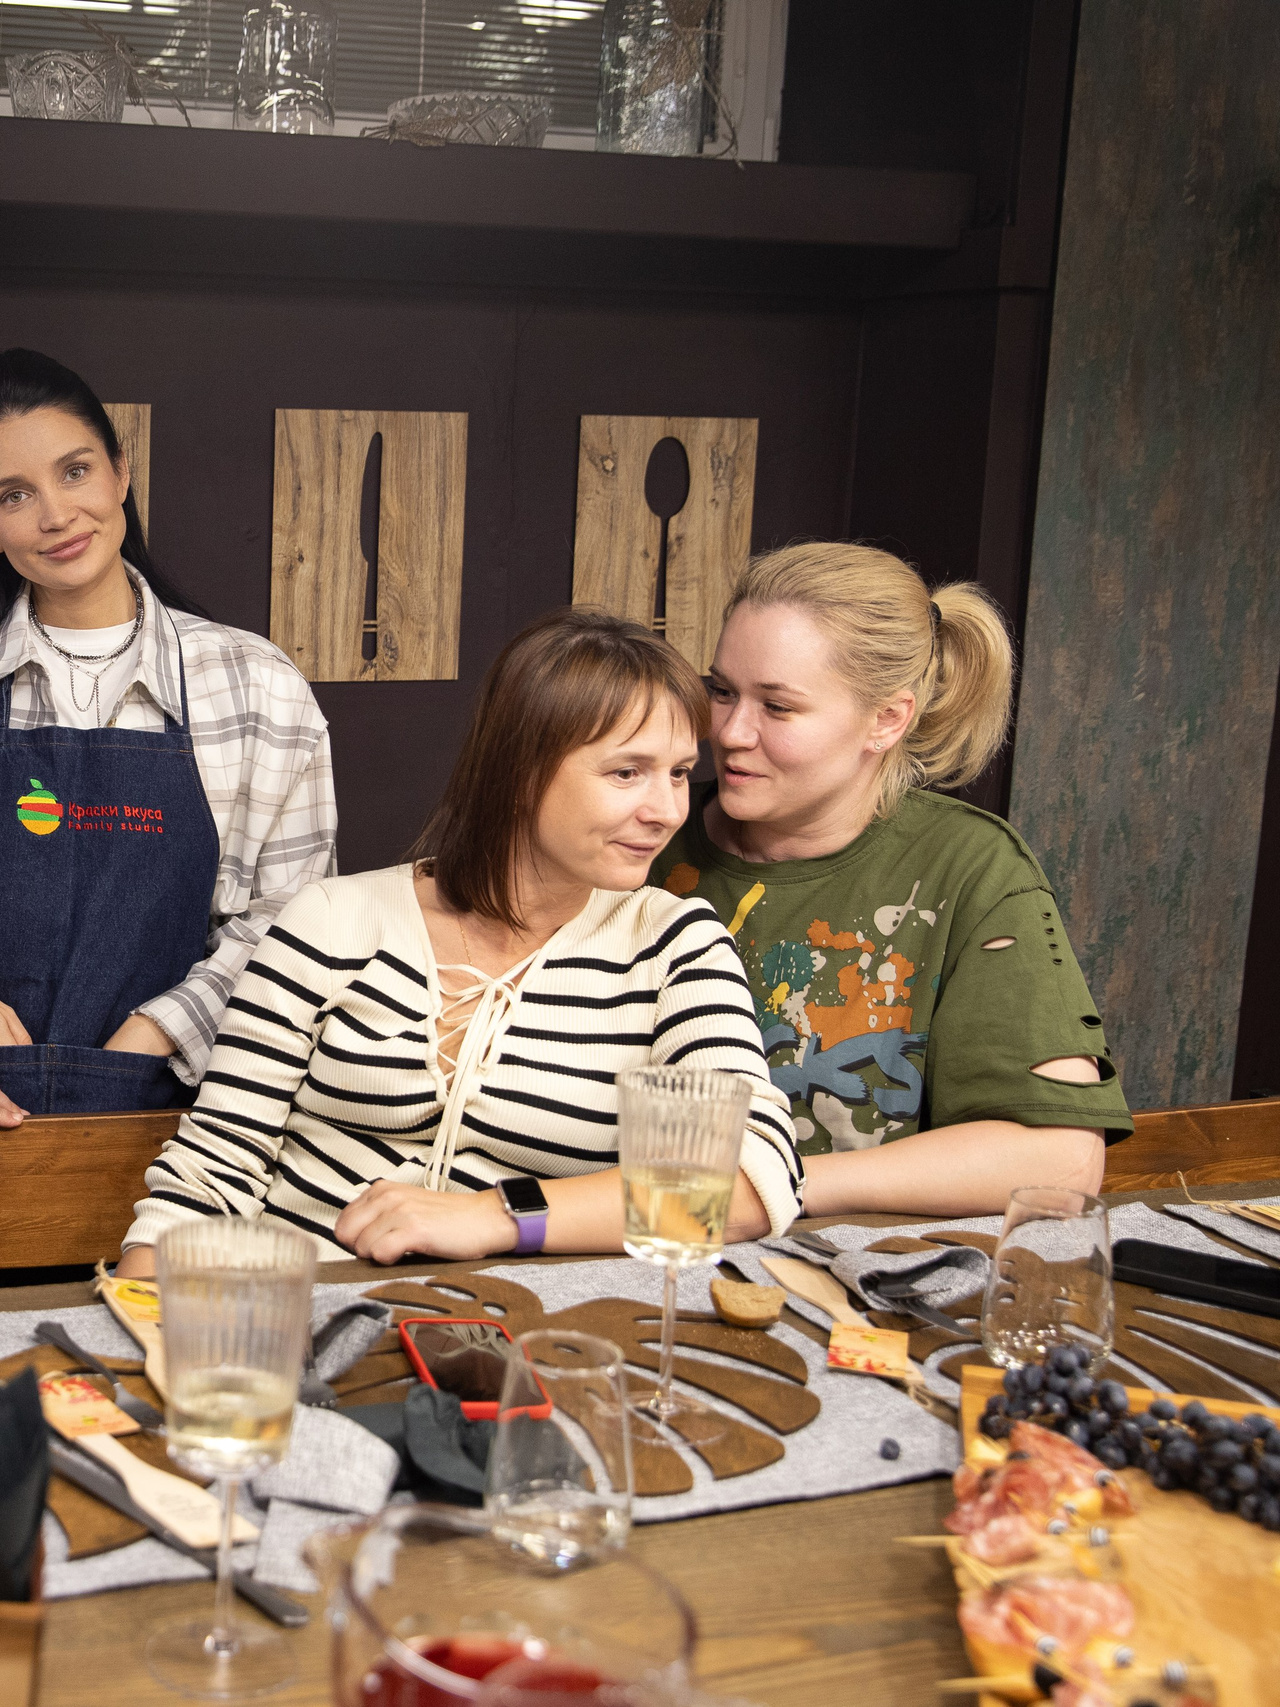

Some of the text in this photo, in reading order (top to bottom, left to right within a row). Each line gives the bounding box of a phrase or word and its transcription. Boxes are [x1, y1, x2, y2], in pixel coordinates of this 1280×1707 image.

[68, 801, 163, 822] Краски вкуса
[68, 821, 163, 833] Family studio
